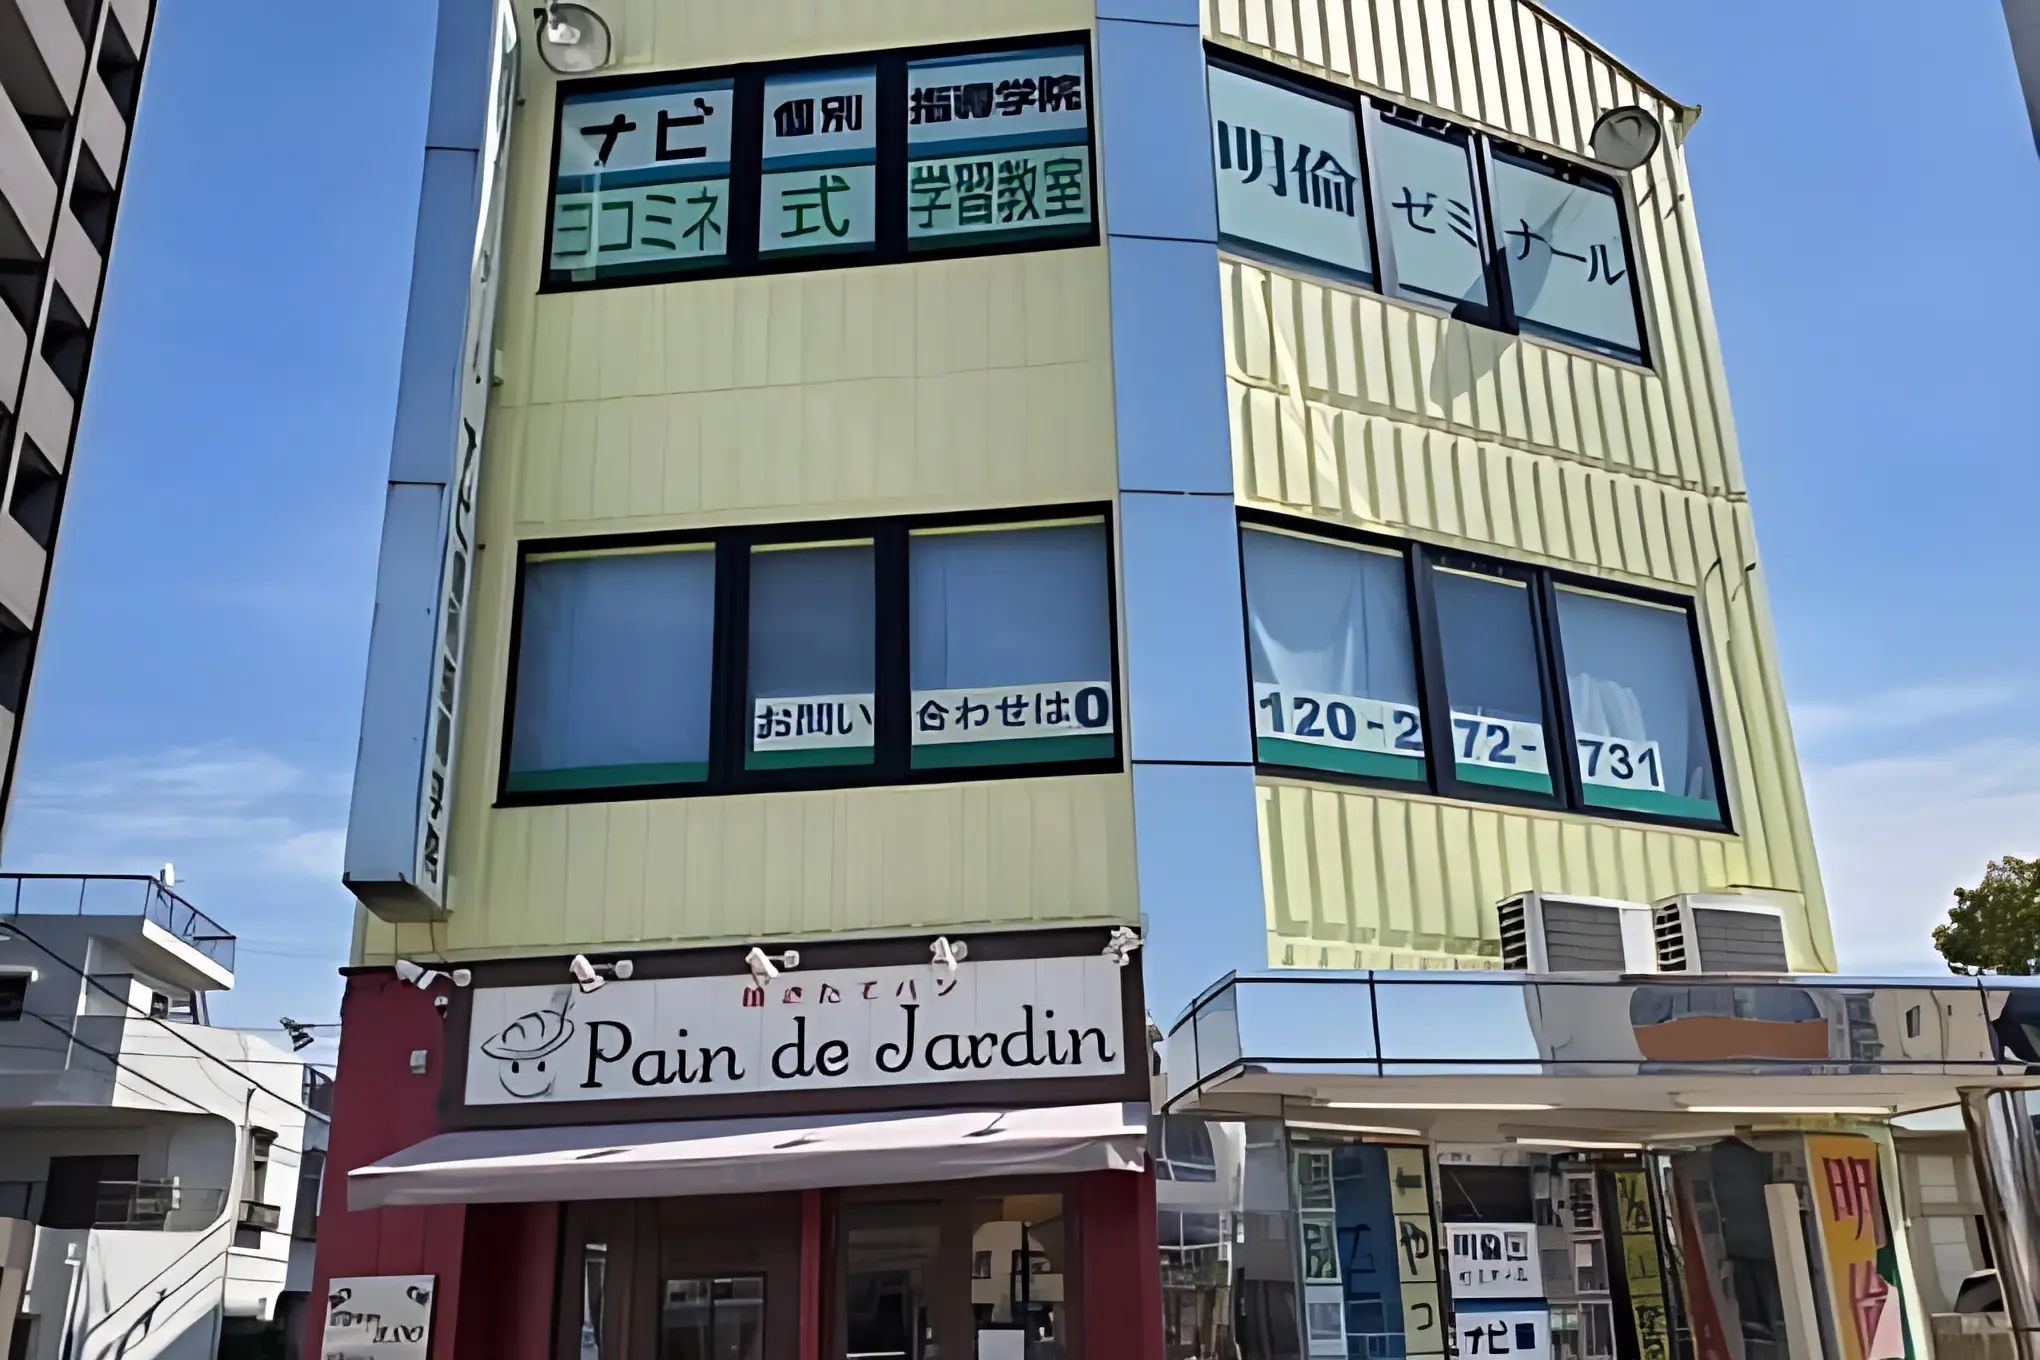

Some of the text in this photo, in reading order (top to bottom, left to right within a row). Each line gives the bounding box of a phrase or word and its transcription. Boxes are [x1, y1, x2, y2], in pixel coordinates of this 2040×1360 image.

[580, 97, 714, 166] ナビ
[773, 93, 863, 138] 個別
[553, 157, 1084, 258] ヨコミネ 式 学習教室
[1217, 120, 1626, 286] 明倫 ゼミ ナール
[1577, 739, 1661, 788] 731
[579, 1003, 1115, 1090] Pain de Jardin
